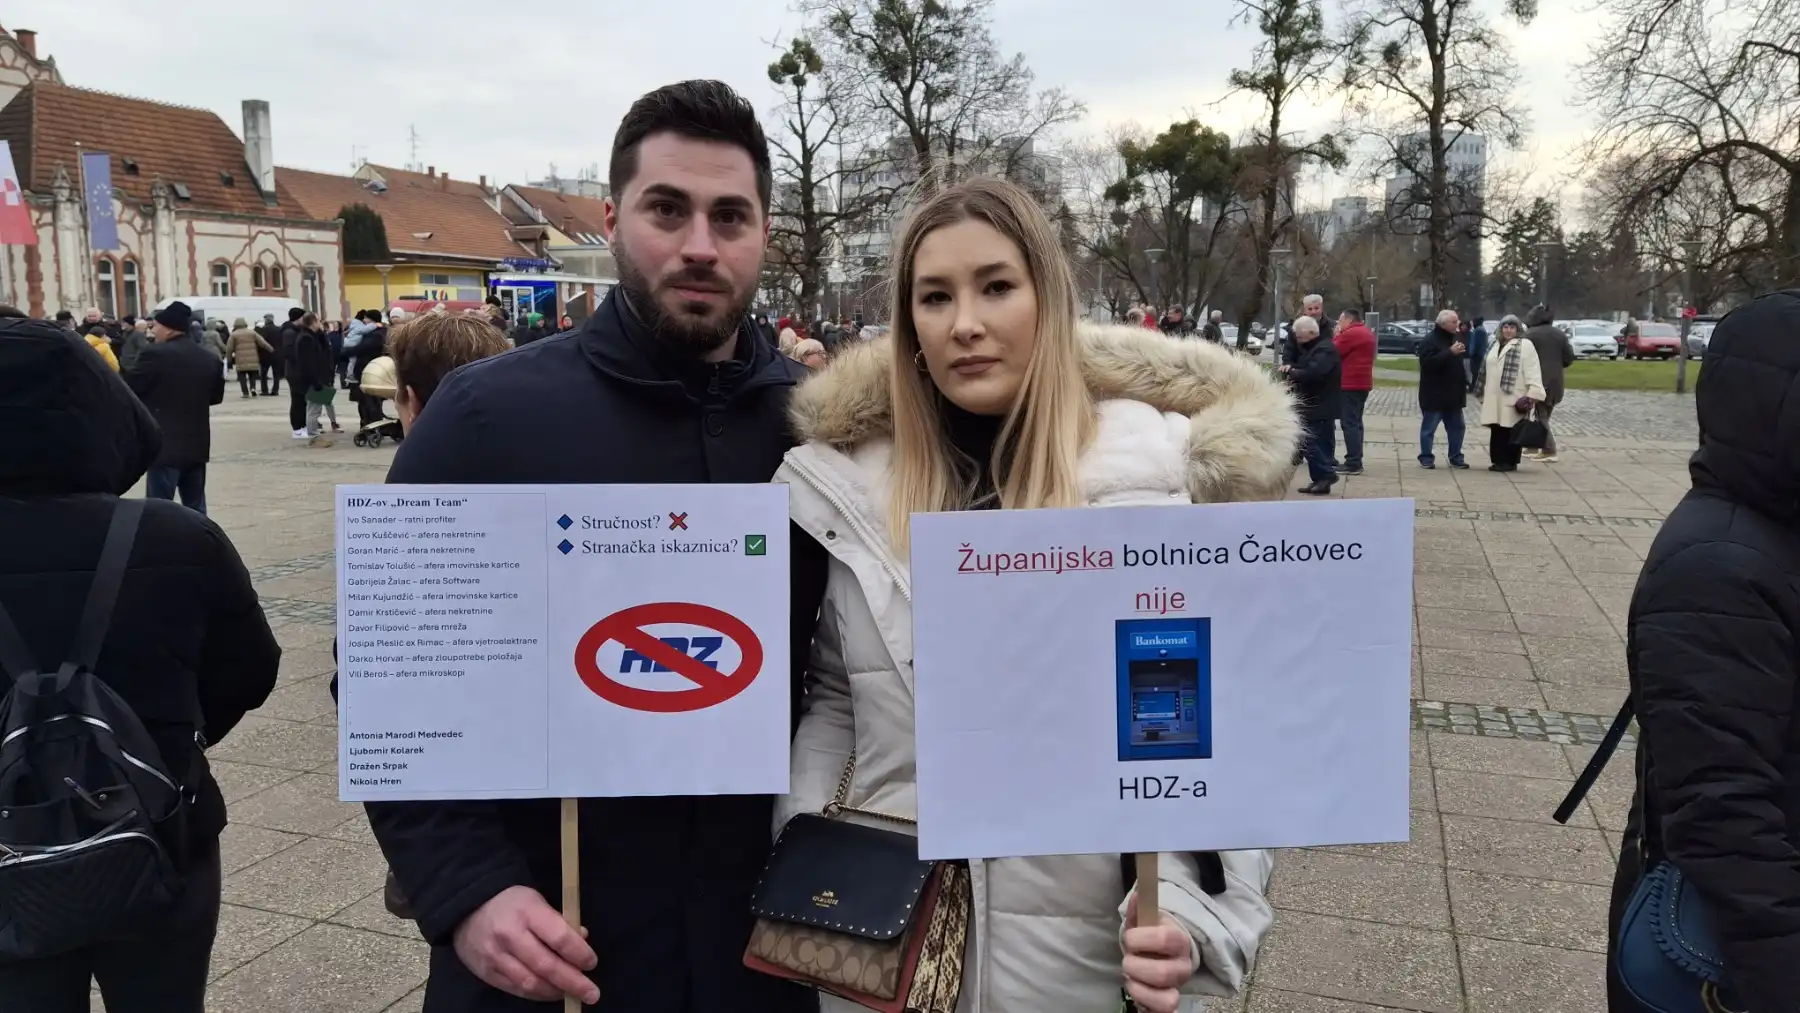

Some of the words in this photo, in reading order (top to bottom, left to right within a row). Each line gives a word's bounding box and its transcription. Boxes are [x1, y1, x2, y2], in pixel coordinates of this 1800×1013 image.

[347, 498, 388, 507] HDZ-ov
[347, 516, 360, 524] Ivo
[361, 516, 396, 524] Sanader
[426, 516, 456, 524] profiter
[581, 514, 660, 530] Stručnost?
[347, 531, 370, 539] Lovro
[441, 530, 486, 538] nekretnine
[430, 546, 476, 554] nekretnine
[582, 540, 656, 554] Stranačka
[660, 538, 738, 554] iskaznica?
[957, 542, 1114, 576] Županijska
[1122, 544, 1230, 566] bolnica
[1238, 534, 1364, 564] Čakovec
[447, 561, 490, 569] imovinske
[491, 560, 520, 568] kartice
[348, 578, 386, 587] Gabrijela
[388, 576, 411, 586] Žalac
[1135, 586, 1186, 614] nije
[424, 608, 446, 616] afera
[441, 622, 468, 631] mreža
[348, 640, 374, 648] Josipa
[417, 638, 444, 646] Rimac
[475, 638, 538, 647] vjetroelektrane
[1136, 636, 1188, 646] Bankomat
[436, 654, 486, 662] zloupotrebe
[488, 652, 523, 662] položaja
[364, 670, 388, 678] Beroš
[396, 670, 418, 678] afera
[420, 669, 465, 678] mikroskopi
[386, 731, 416, 740] Marodi
[418, 730, 464, 738] Medvedec
[349, 746, 388, 756] Ljubomir
[390, 746, 425, 754] Kolarek
[349, 762, 381, 770] Dražen
[382, 762, 408, 770] Srpak
[349, 777, 379, 786] Nikola
[380, 777, 402, 785] Hren
[1119, 776, 1208, 800] HDZ-a
